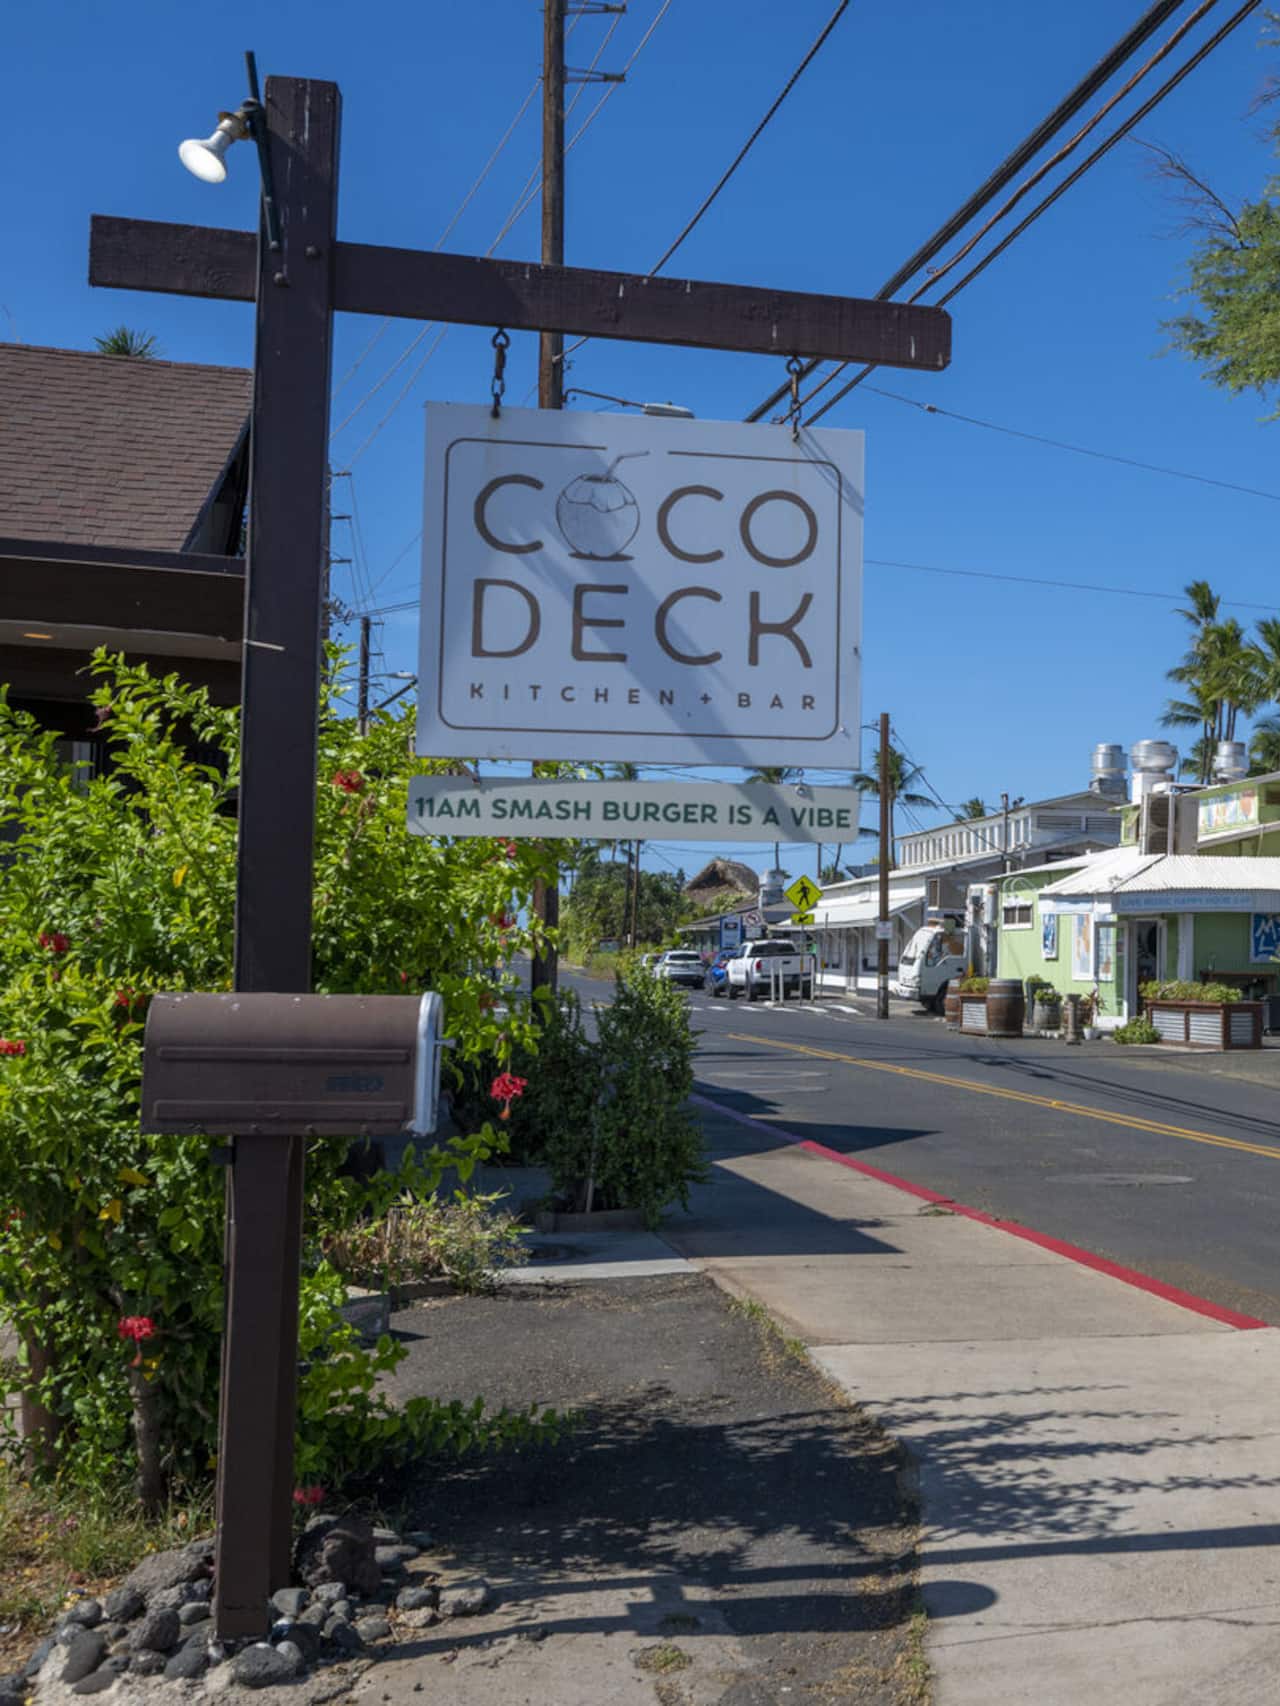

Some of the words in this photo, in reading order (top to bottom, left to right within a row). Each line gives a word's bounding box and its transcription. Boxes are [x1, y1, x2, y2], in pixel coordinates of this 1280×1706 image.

[471, 577, 814, 669] DECK
[469, 682, 675, 706] KITCHEN
[700, 692, 712, 705] +
[737, 692, 816, 711] BAR
[415, 797, 481, 819] 11AM
[491, 799, 592, 821] SMASH
[602, 801, 718, 824] BURGER
[728, 804, 752, 825] IS
[762, 806, 781, 827] A
[790, 807, 851, 829] VIBE
